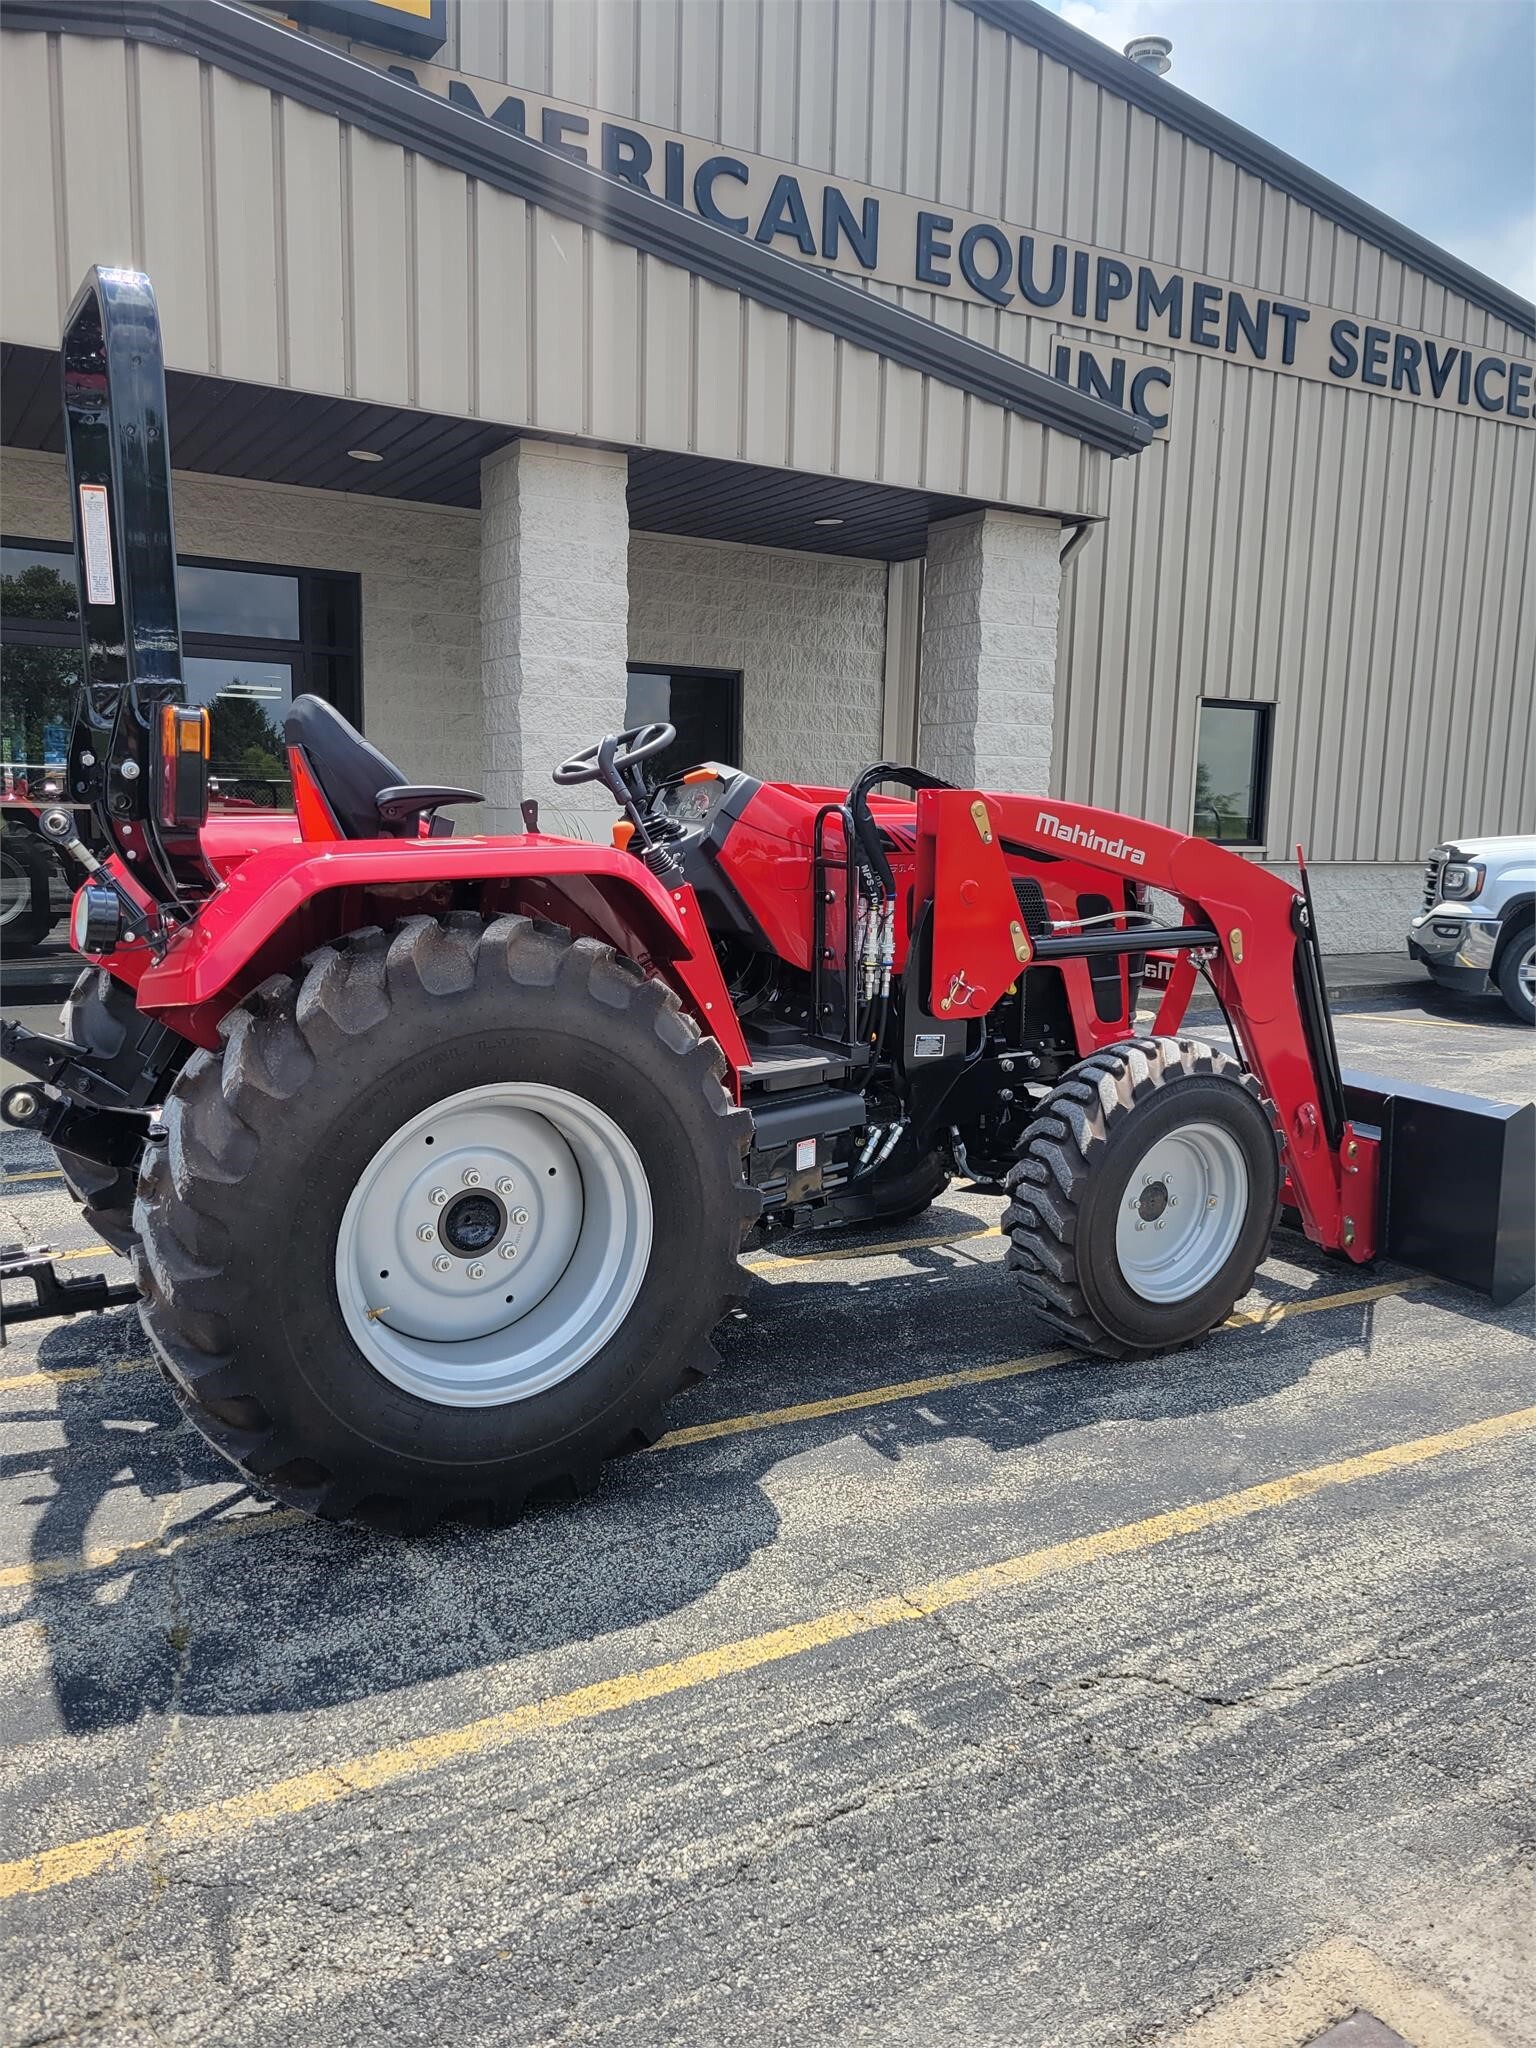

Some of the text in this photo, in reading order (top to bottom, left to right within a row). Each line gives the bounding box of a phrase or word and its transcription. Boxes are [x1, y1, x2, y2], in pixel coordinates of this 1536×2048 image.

[387, 65, 1536, 422] ERICAN EQUIPMENT SERVICE
[1055, 344, 1172, 430] INC
[1035, 811, 1146, 866] Mahindra
[860, 864, 880, 907] NPS-10
